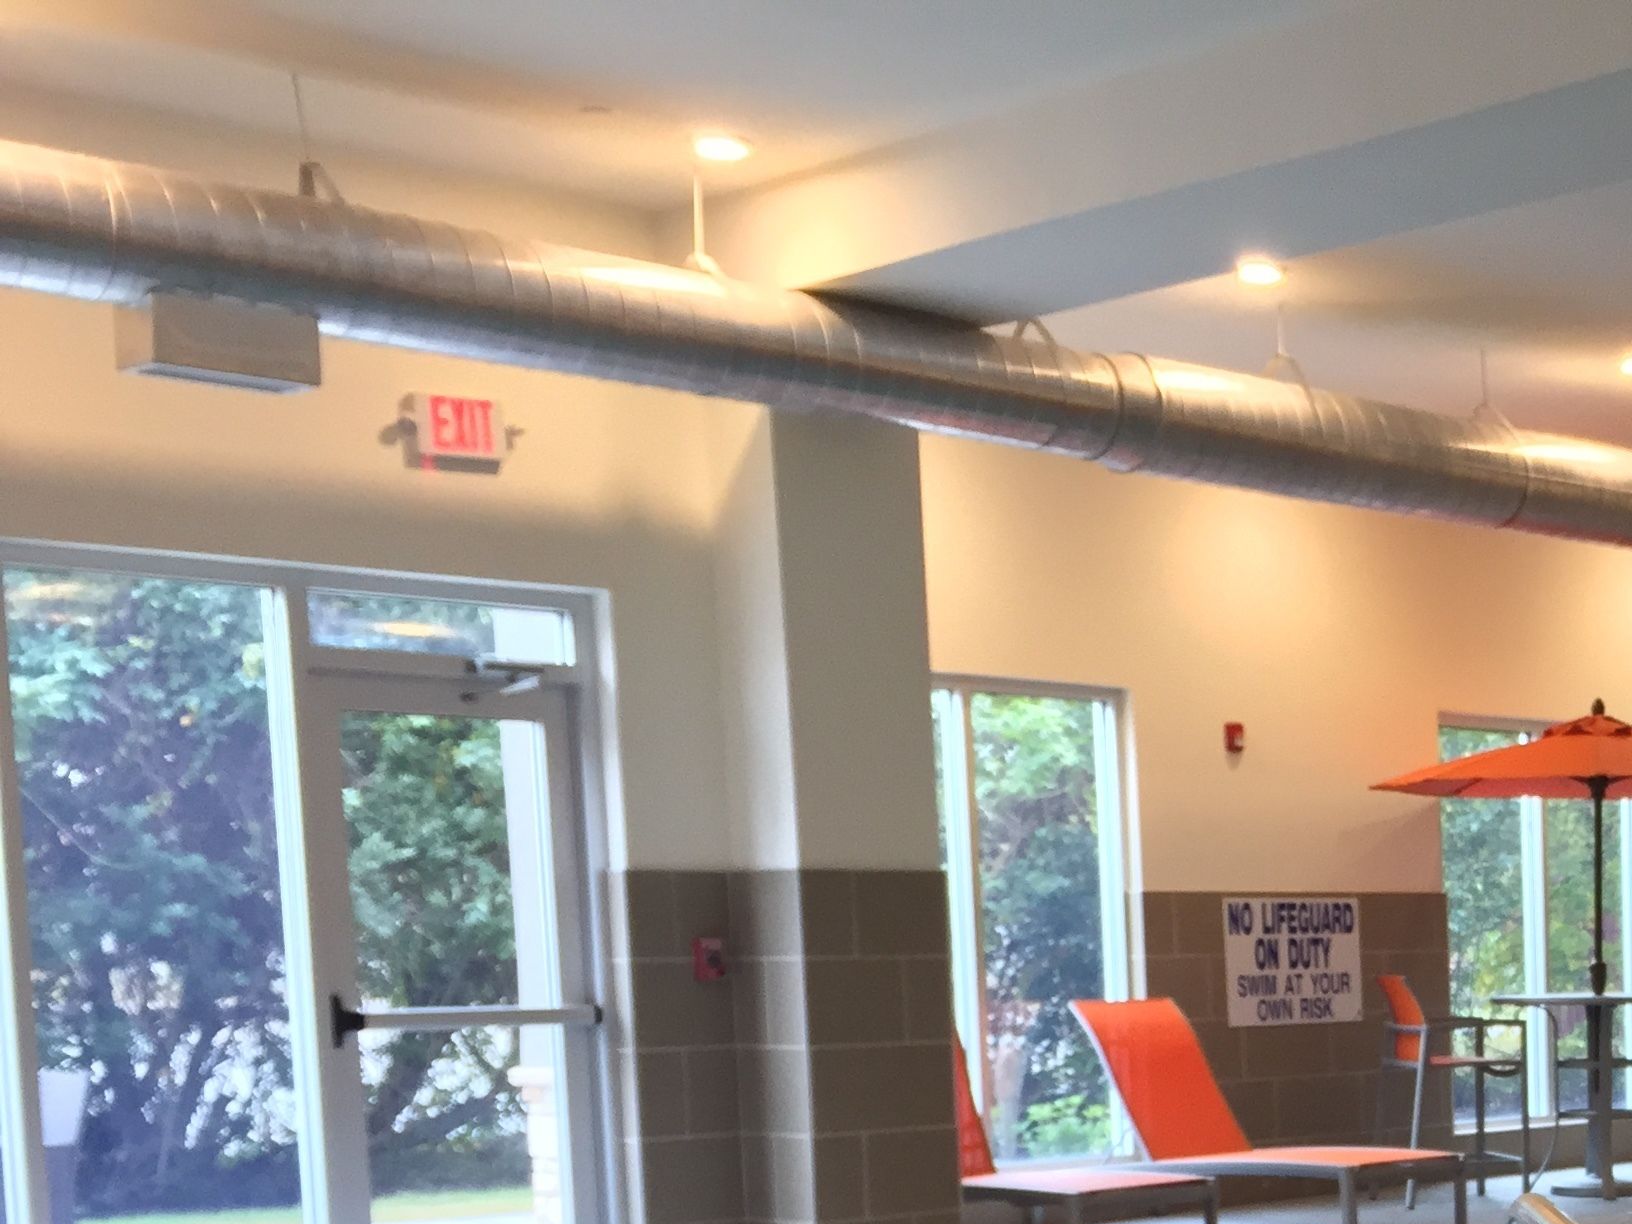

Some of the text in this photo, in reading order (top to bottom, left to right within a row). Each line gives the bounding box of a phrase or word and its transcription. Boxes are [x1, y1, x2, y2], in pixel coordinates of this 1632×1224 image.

[429, 395, 493, 453] EXIT
[1227, 902, 1354, 935] NO LIFEGUARD
[1255, 938, 1331, 970] ON DUTY
[1237, 972, 1350, 998] SWIM AT YOUR
[1257, 997, 1334, 1021] OWN RISK
